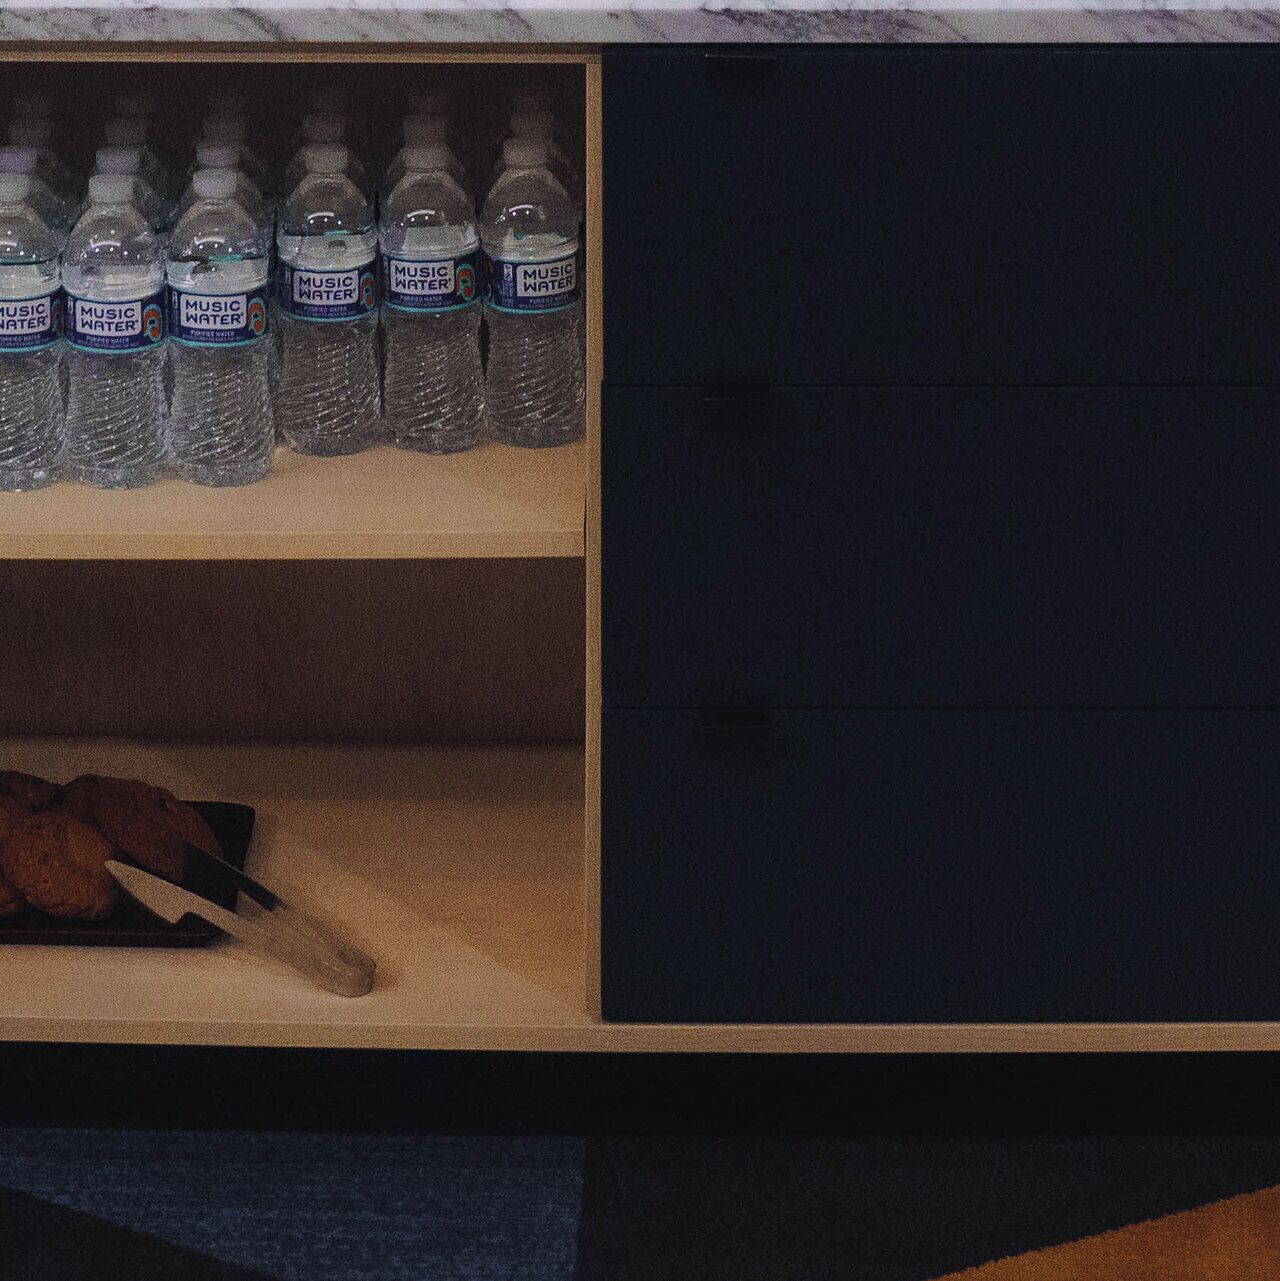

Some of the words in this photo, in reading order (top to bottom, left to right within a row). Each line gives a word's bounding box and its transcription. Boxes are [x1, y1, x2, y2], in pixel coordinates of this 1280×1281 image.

[394, 265, 448, 278] MUSIC
[523, 263, 573, 280] MUSIC
[298, 276, 353, 289] MUSIC
[395, 278, 449, 290] WATER
[524, 276, 573, 292] WATER
[299, 288, 354, 301] WATER
[80, 306, 135, 319] MUSIC
[185, 299, 240, 313] MUSIC
[81, 319, 136, 332] WATER
[186, 312, 241, 326] WATER
